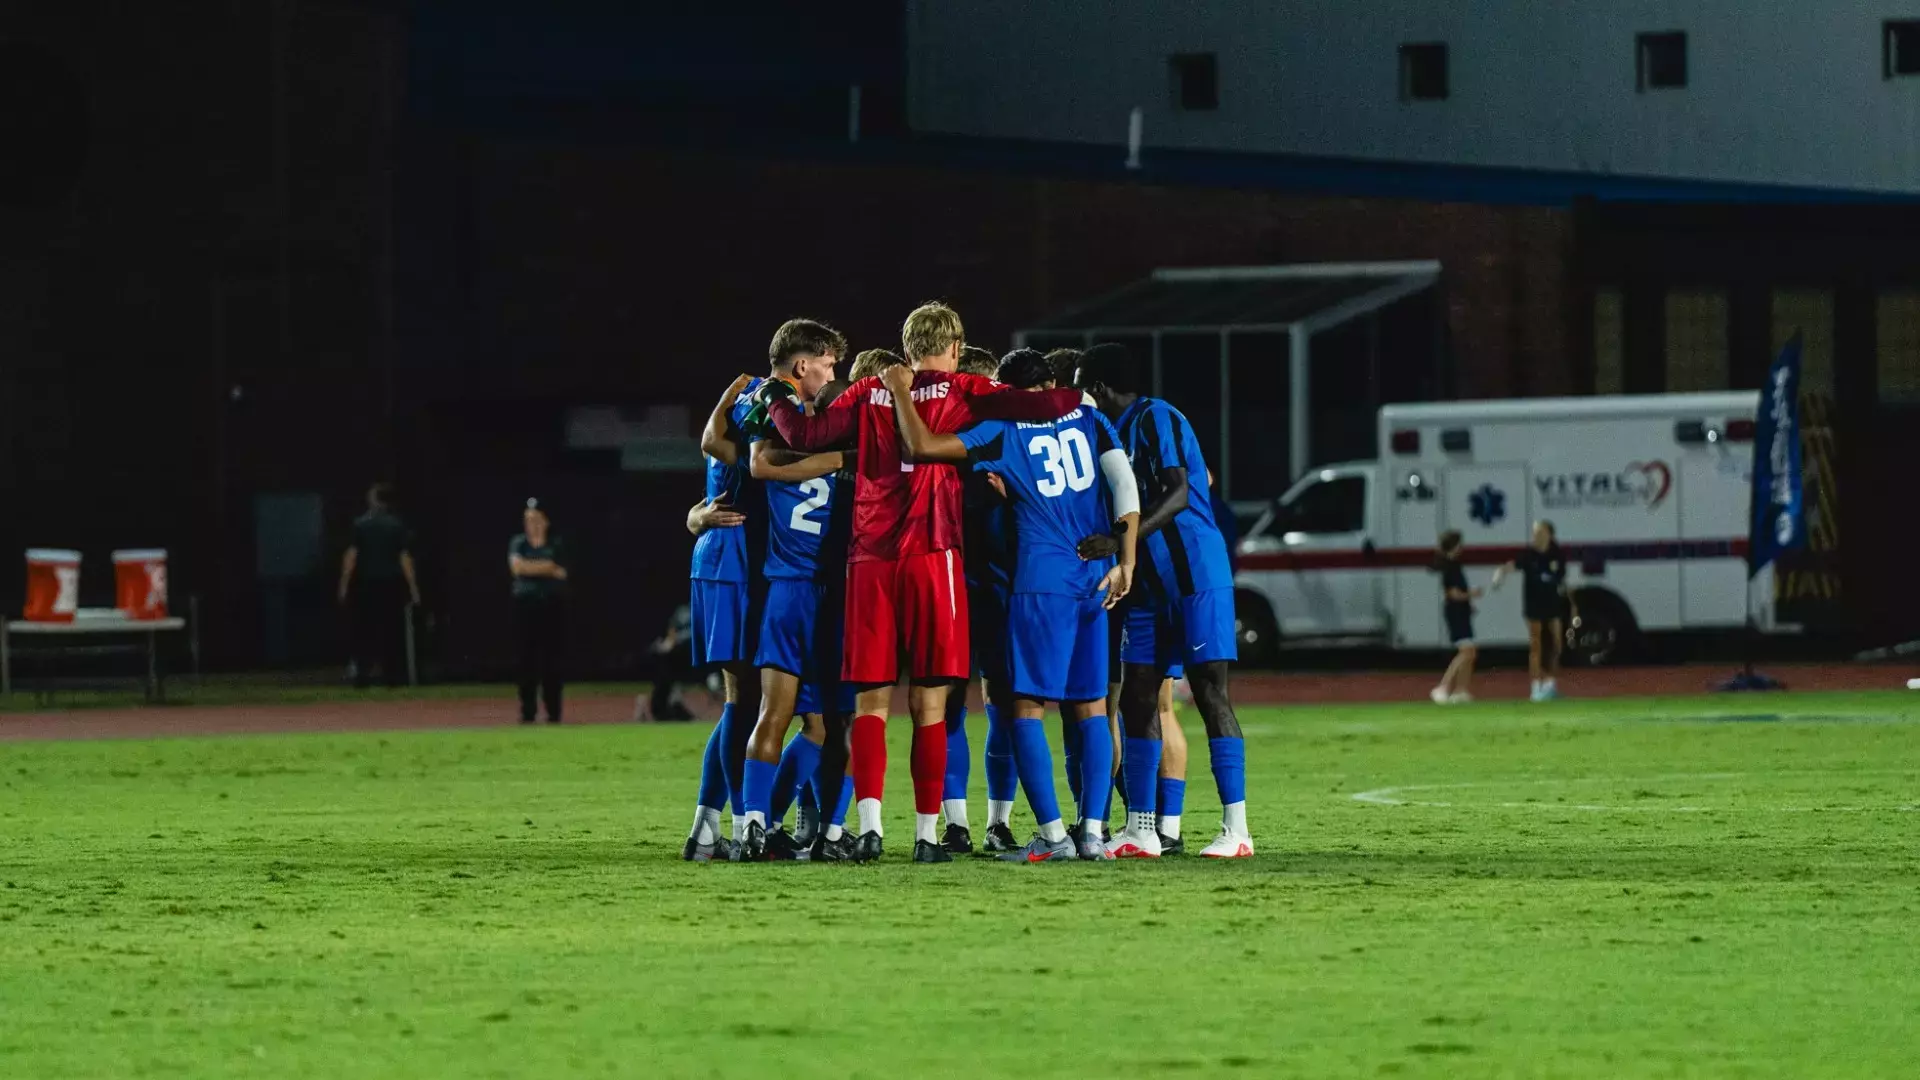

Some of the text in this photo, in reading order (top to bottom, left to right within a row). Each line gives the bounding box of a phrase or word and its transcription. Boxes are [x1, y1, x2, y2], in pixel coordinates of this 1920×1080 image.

[870, 381, 950, 407] MEPHIS
[1029, 427, 1096, 497] 30
[790, 477, 830, 535] 2
